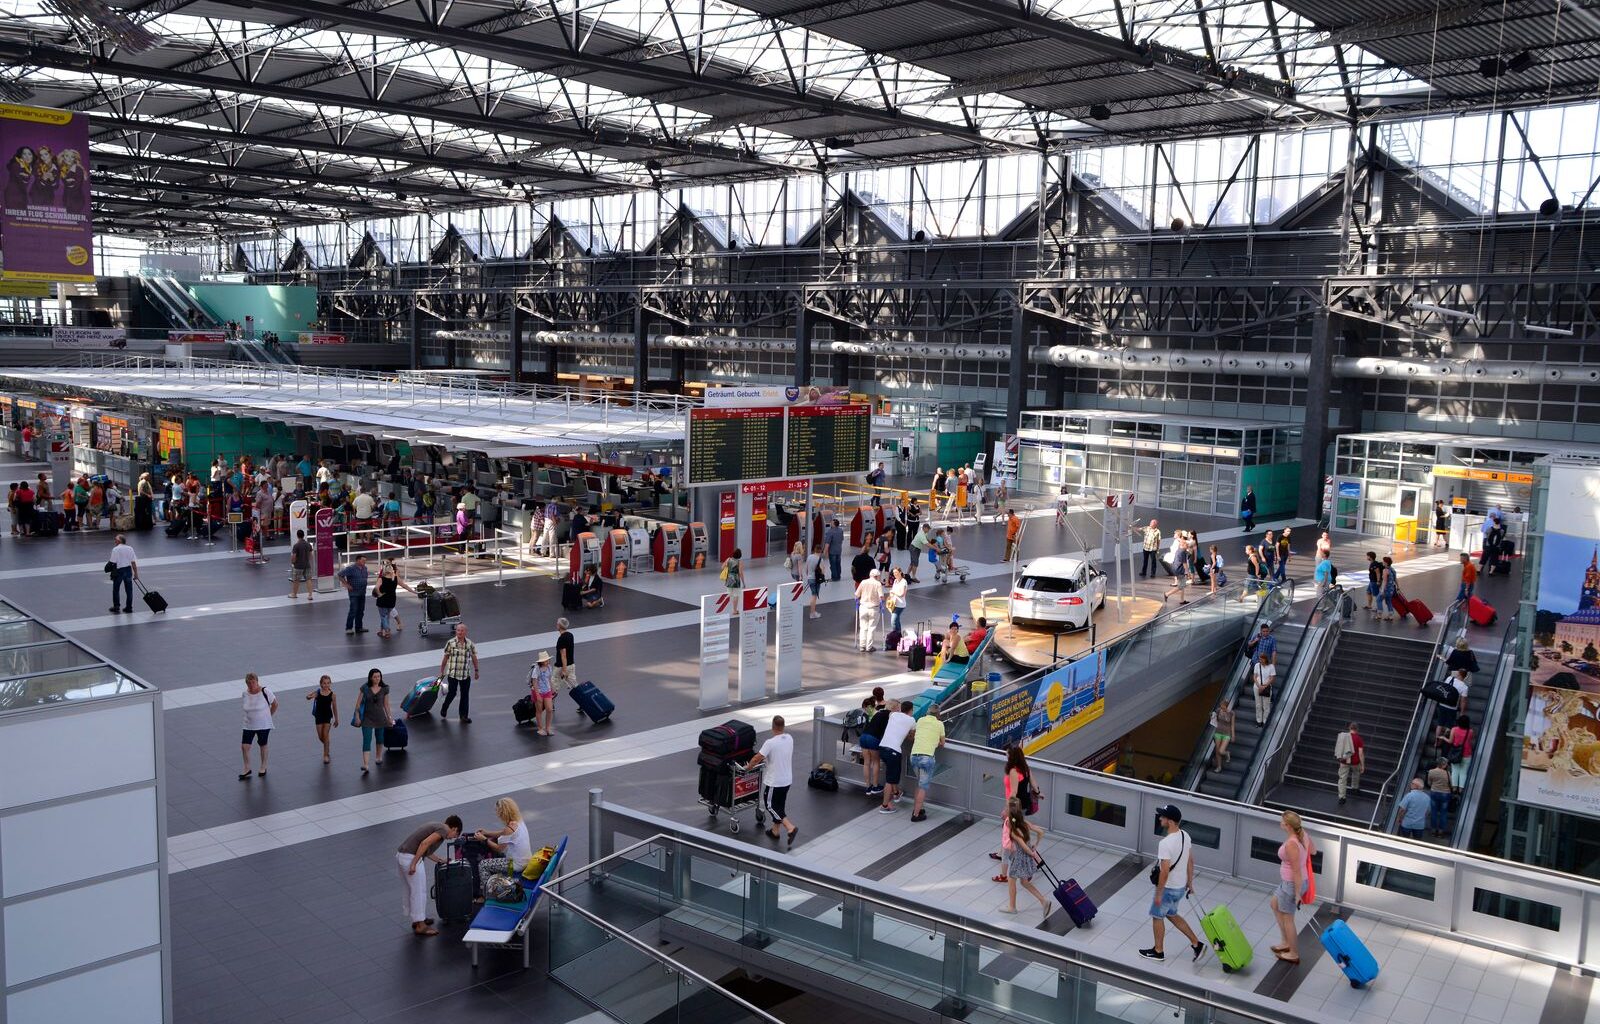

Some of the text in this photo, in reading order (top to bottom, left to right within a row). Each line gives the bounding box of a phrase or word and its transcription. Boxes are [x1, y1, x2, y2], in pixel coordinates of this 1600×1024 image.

[28, 210, 44, 218] FLUG
[991, 706, 1013, 721] DRESDEN
[1004, 706, 1030, 725] BARCELONA
